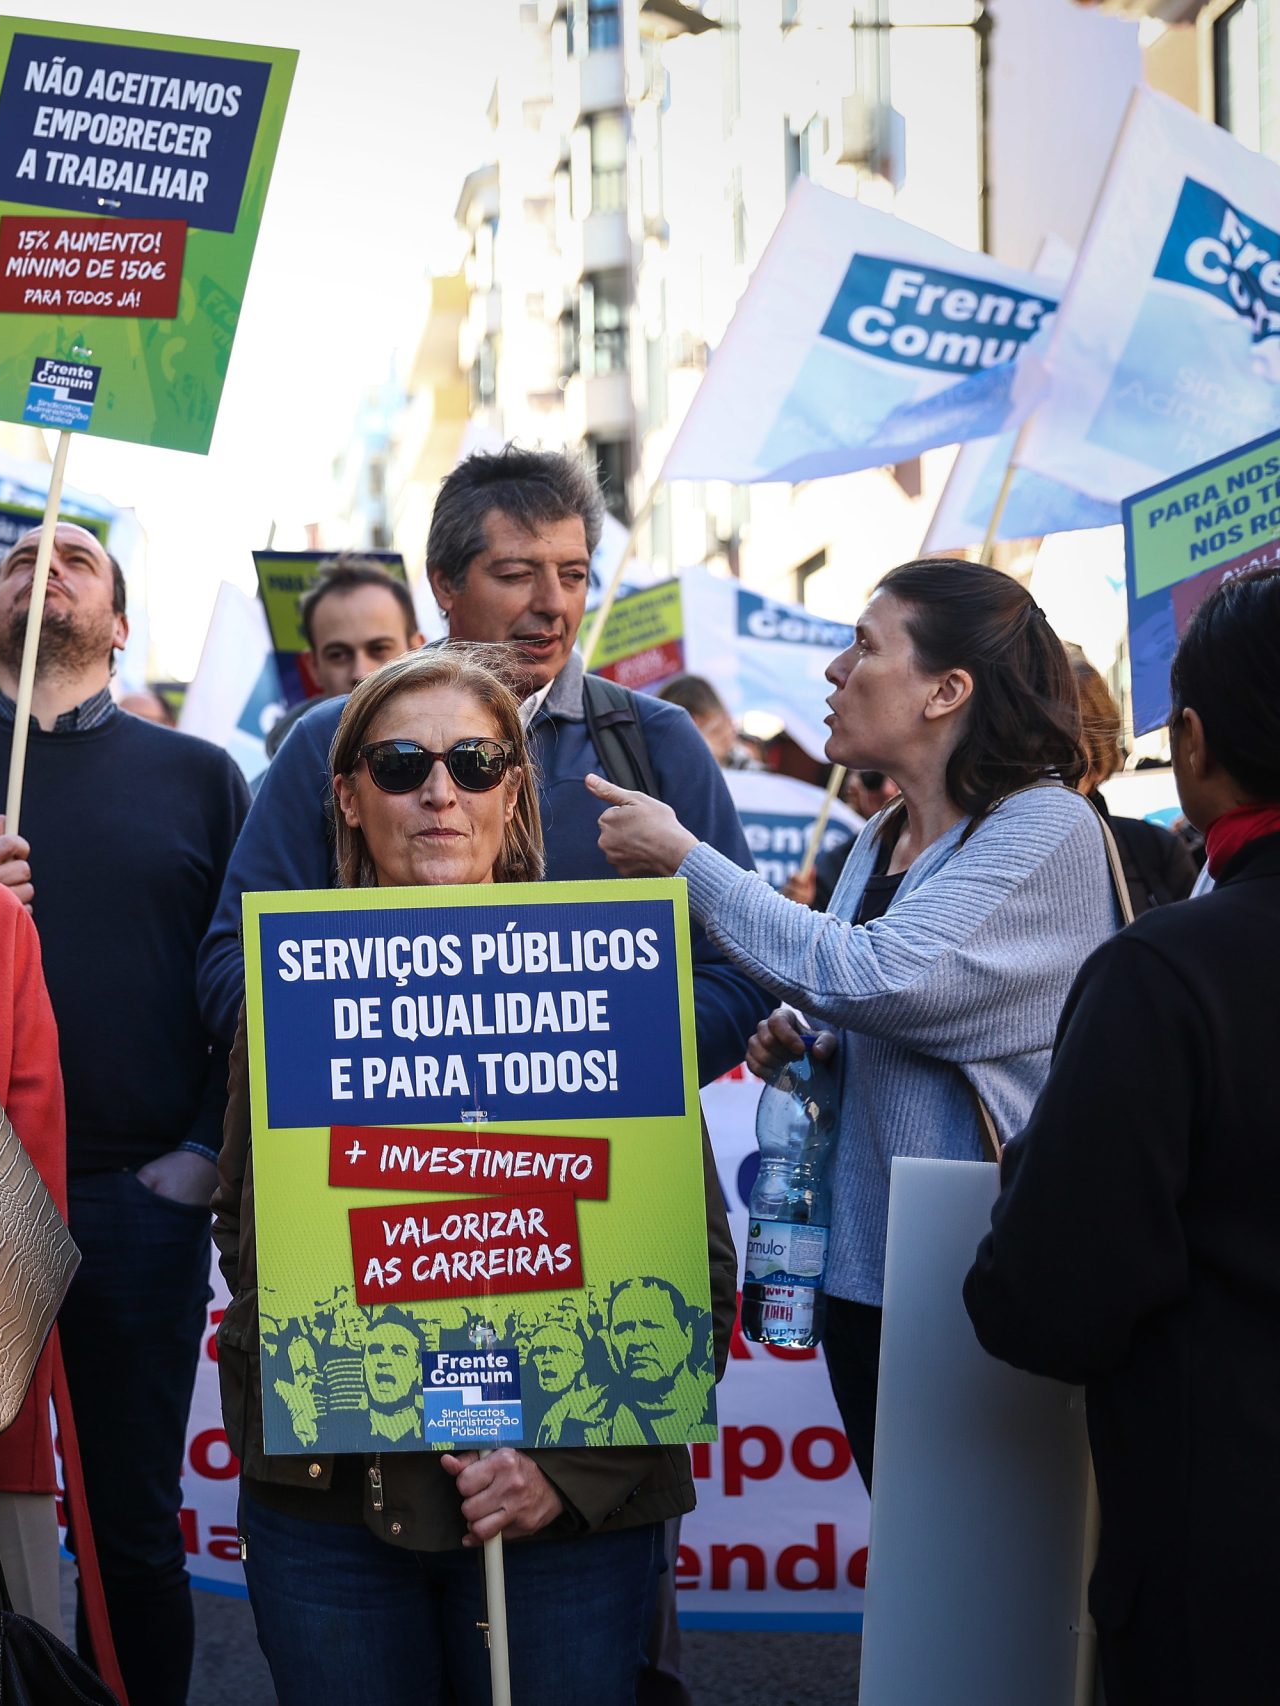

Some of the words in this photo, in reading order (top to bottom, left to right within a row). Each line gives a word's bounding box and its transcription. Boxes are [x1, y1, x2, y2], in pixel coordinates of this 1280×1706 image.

[25, 57, 83, 96] NÃO
[85, 69, 241, 116] ACEITAMOS
[34, 107, 211, 158] EMPOBRECER
[16, 149, 36, 179] A
[46, 151, 208, 202] TRABALHAR
[19, 231, 50, 249] 15%
[55, 231, 161, 253] AUMENTO!
[6, 252, 80, 278] MÍNIMO
[86, 259, 115, 278] DE
[121, 261, 165, 280] 150€
[25, 289, 61, 304] PARA
[67, 291, 113, 305] TODOS
[117, 289, 140, 307] JÁ!
[37, 371, 93, 390] Comum
[45, 361, 93, 379] Frente
[1149, 484, 1220, 529] PARA
[1194, 498, 1251, 534] NÃO
[1189, 523, 1244, 561] NOS
[744, 824, 845, 853] ente
[279, 935, 462, 986] SERVIÇOS
[472, 922, 659, 974] PÚBLICOS
[334, 998, 382, 1039] DE
[392, 990, 609, 1041] QUALIDADE
[331, 1059, 353, 1099] E
[363, 1055, 470, 1098] PARA
[478, 1050, 617, 1094] TODOS!
[345, 1141, 366, 1163] +
[380, 1145, 592, 1182] INVESTIMENTO
[383, 1208, 548, 1247] VALORIZAR
[364, 1258, 401, 1288] AS
[413, 1244, 571, 1282] CARREIRAS
[431, 1369, 512, 1384] Comum
[437, 1353, 508, 1369] Frente
[428, 1416, 519, 1428] Administração
[441, 1408, 505, 1418] Sindicatos
[452, 1427, 498, 1436] Pública
